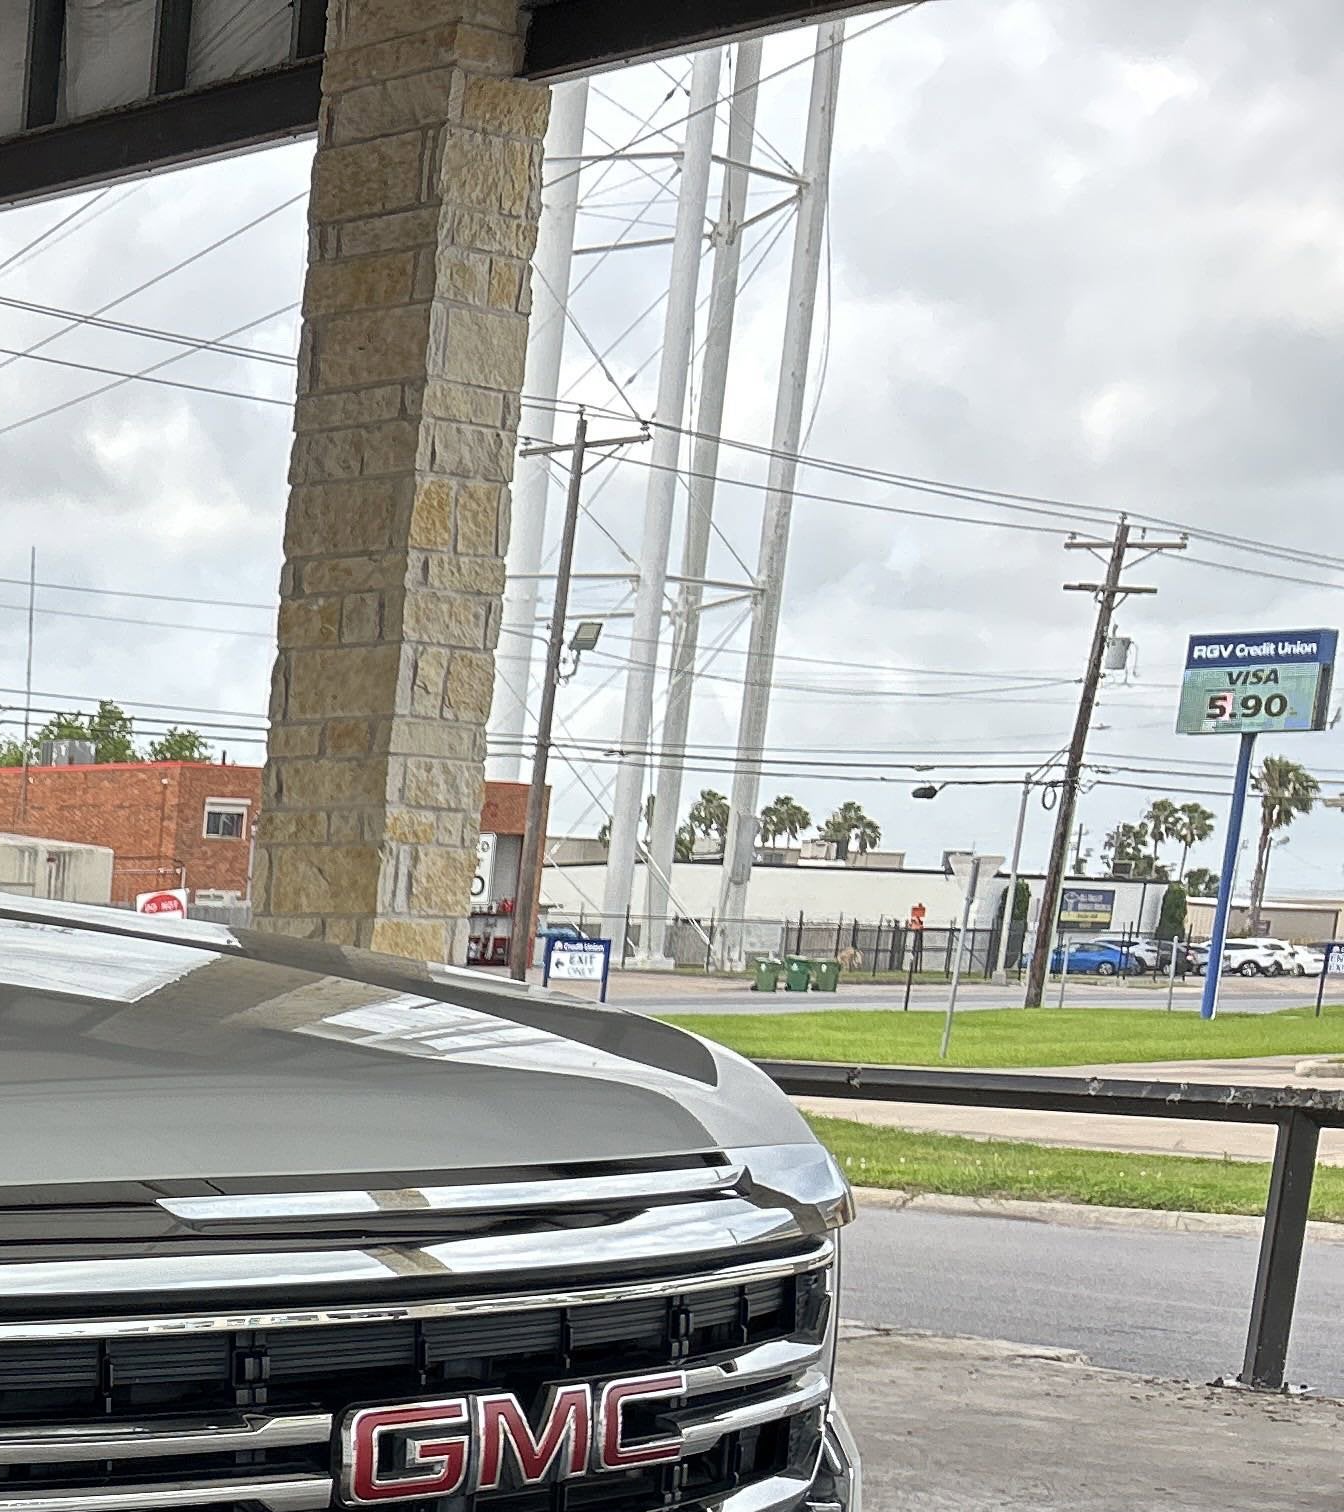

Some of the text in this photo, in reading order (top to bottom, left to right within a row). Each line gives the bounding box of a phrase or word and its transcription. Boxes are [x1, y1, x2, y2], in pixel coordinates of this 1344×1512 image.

[1193, 640, 1317, 659] RGV Credit Union
[1227, 667, 1279, 686] VISA
[1206, 692, 1288, 719] 5.90
[342, 1370, 687, 1504] GMC
